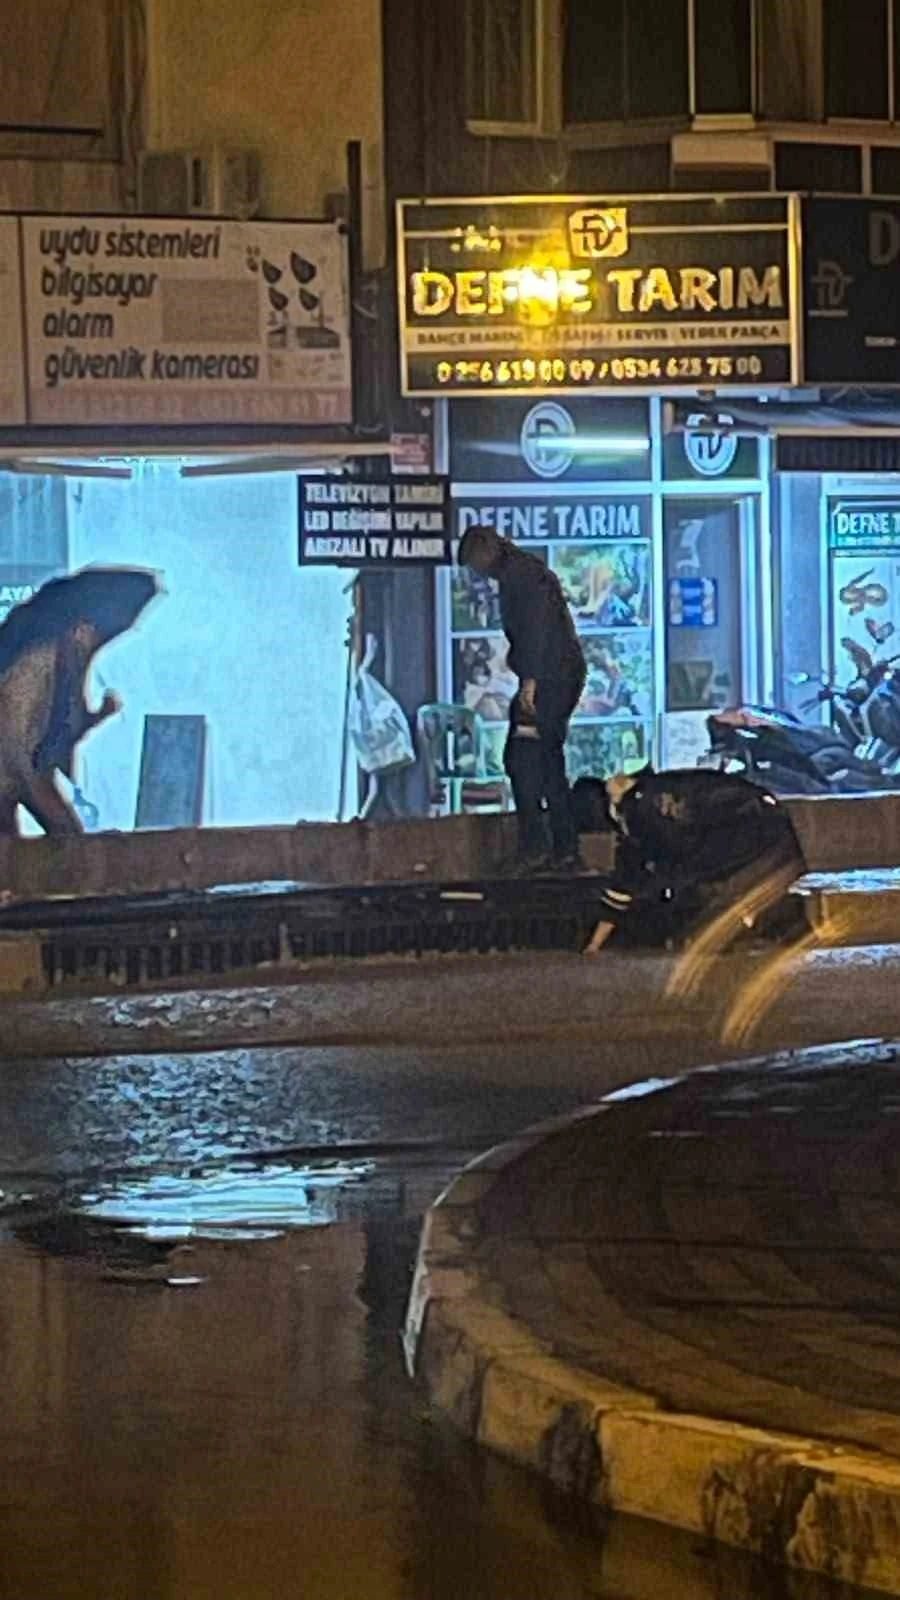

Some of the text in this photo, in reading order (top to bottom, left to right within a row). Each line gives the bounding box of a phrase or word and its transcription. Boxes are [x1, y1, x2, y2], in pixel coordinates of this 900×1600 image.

[40, 225, 220, 262] uydu sistemleri
[41, 265, 158, 304] bilgisayar
[412, 266, 592, 316] DEFNE
[607, 265, 783, 313] TARIM
[43, 309, 114, 338] alarm
[45, 347, 258, 386] güvenlik kamerası
[706, 357, 732, 377] 75
[736, 355, 762, 375] 00
[553, 504, 640, 536] TARIM
[370, 538, 389, 557] TV
